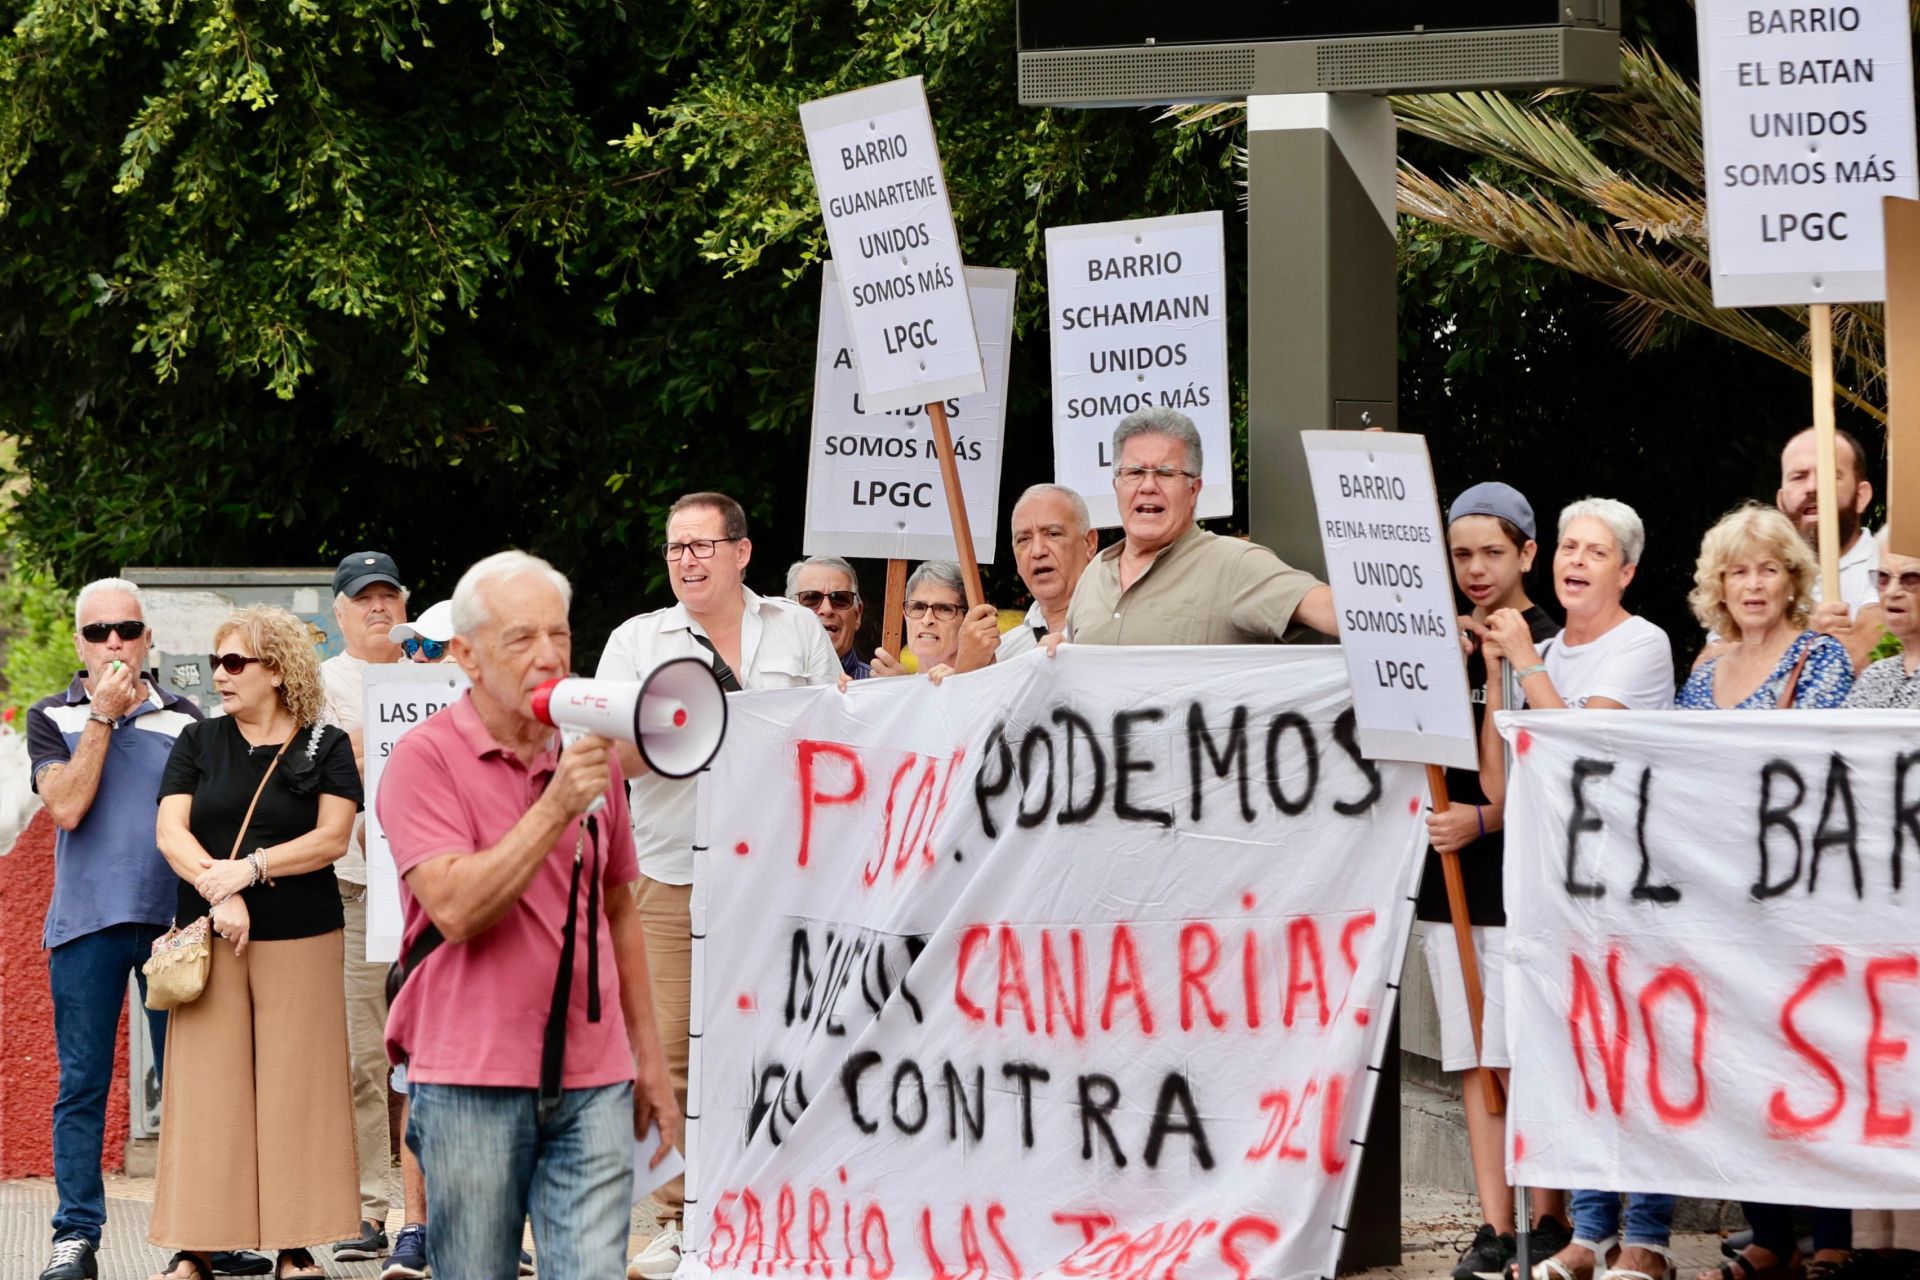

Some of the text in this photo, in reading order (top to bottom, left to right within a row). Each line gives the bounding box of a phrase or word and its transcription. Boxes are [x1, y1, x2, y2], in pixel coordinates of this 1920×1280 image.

[1749, 7, 1860, 35] BARRIO
[1738, 58, 1874, 87] EL BATAN
[1750, 110, 1867, 138] UNIDOS
[841, 134, 908, 171] BARRIO
[1724, 154, 1896, 187] SOMOS MÁS
[829, 175, 938, 218] GUANARTEME
[859, 223, 930, 260] UNIDOS
[1762, 212, 1848, 242] LPGC
[1088, 251, 1183, 282] BARRIO
[853, 265, 954, 308] SOMOS MÁS
[1062, 294, 1210, 330] SCHAMANN
[884, 319, 938, 355] LPGC
[1090, 343, 1188, 374] UNIDOS
[1067, 385, 1211, 419] SOMOS MÁS
[825, 436, 918, 459] SOMOS
[853, 480, 933, 508] LPGC
[1339, 474, 1406, 501] BARRIO
[1326, 520, 1431, 544] REINA MERCEDES
[1353, 561, 1423, 589] UNIDOS
[1346, 608, 1446, 637] SOMOS MÁS
[1375, 659, 1429, 691] LPGC
[380, 703, 418, 723] LAS
[975, 702, 1382, 838] PODEMOS
[1565, 757, 1682, 903] EL
[1569, 945, 1919, 1145] NO SE
[841, 1049, 1217, 1171] CONTRA
[705, 1166, 895, 1280] BARRIO
[922, 1203, 1024, 1280] LAS
